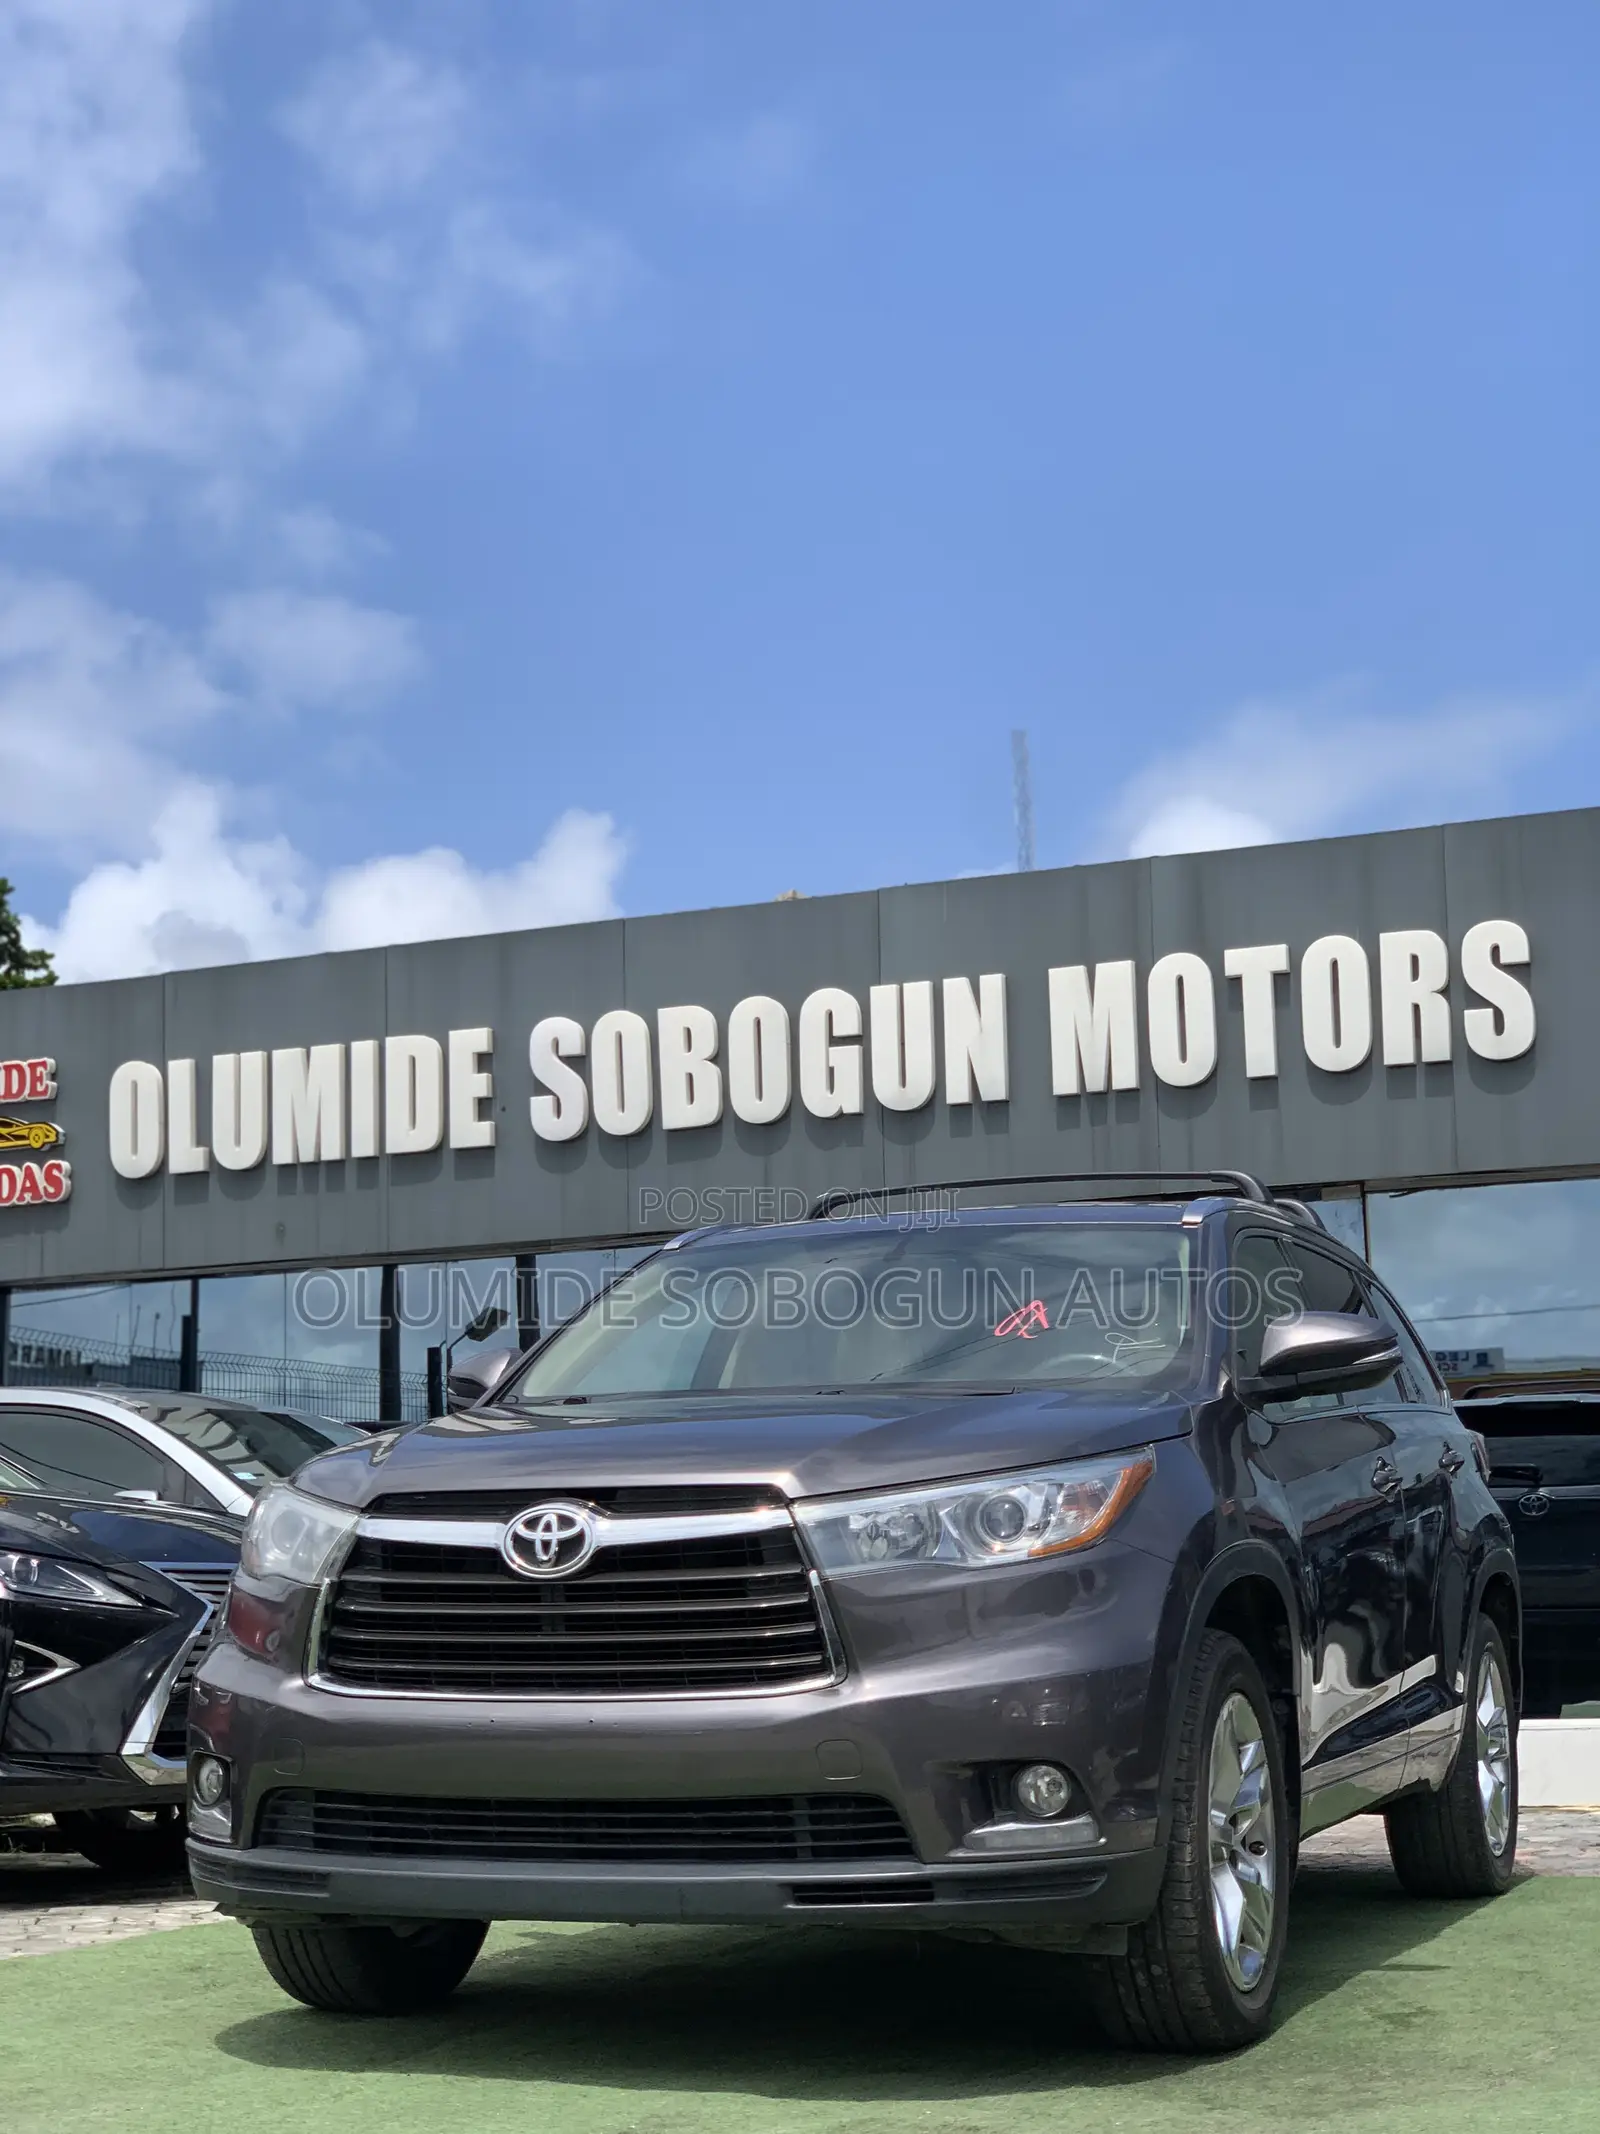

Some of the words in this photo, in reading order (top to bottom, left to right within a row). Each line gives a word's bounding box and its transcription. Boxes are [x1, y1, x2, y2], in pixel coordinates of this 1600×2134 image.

[109, 1027, 496, 1179] OLUMIDE
[529, 973, 1010, 1142] SOBOGUN
[1048, 919, 1536, 1097] MOTORS
